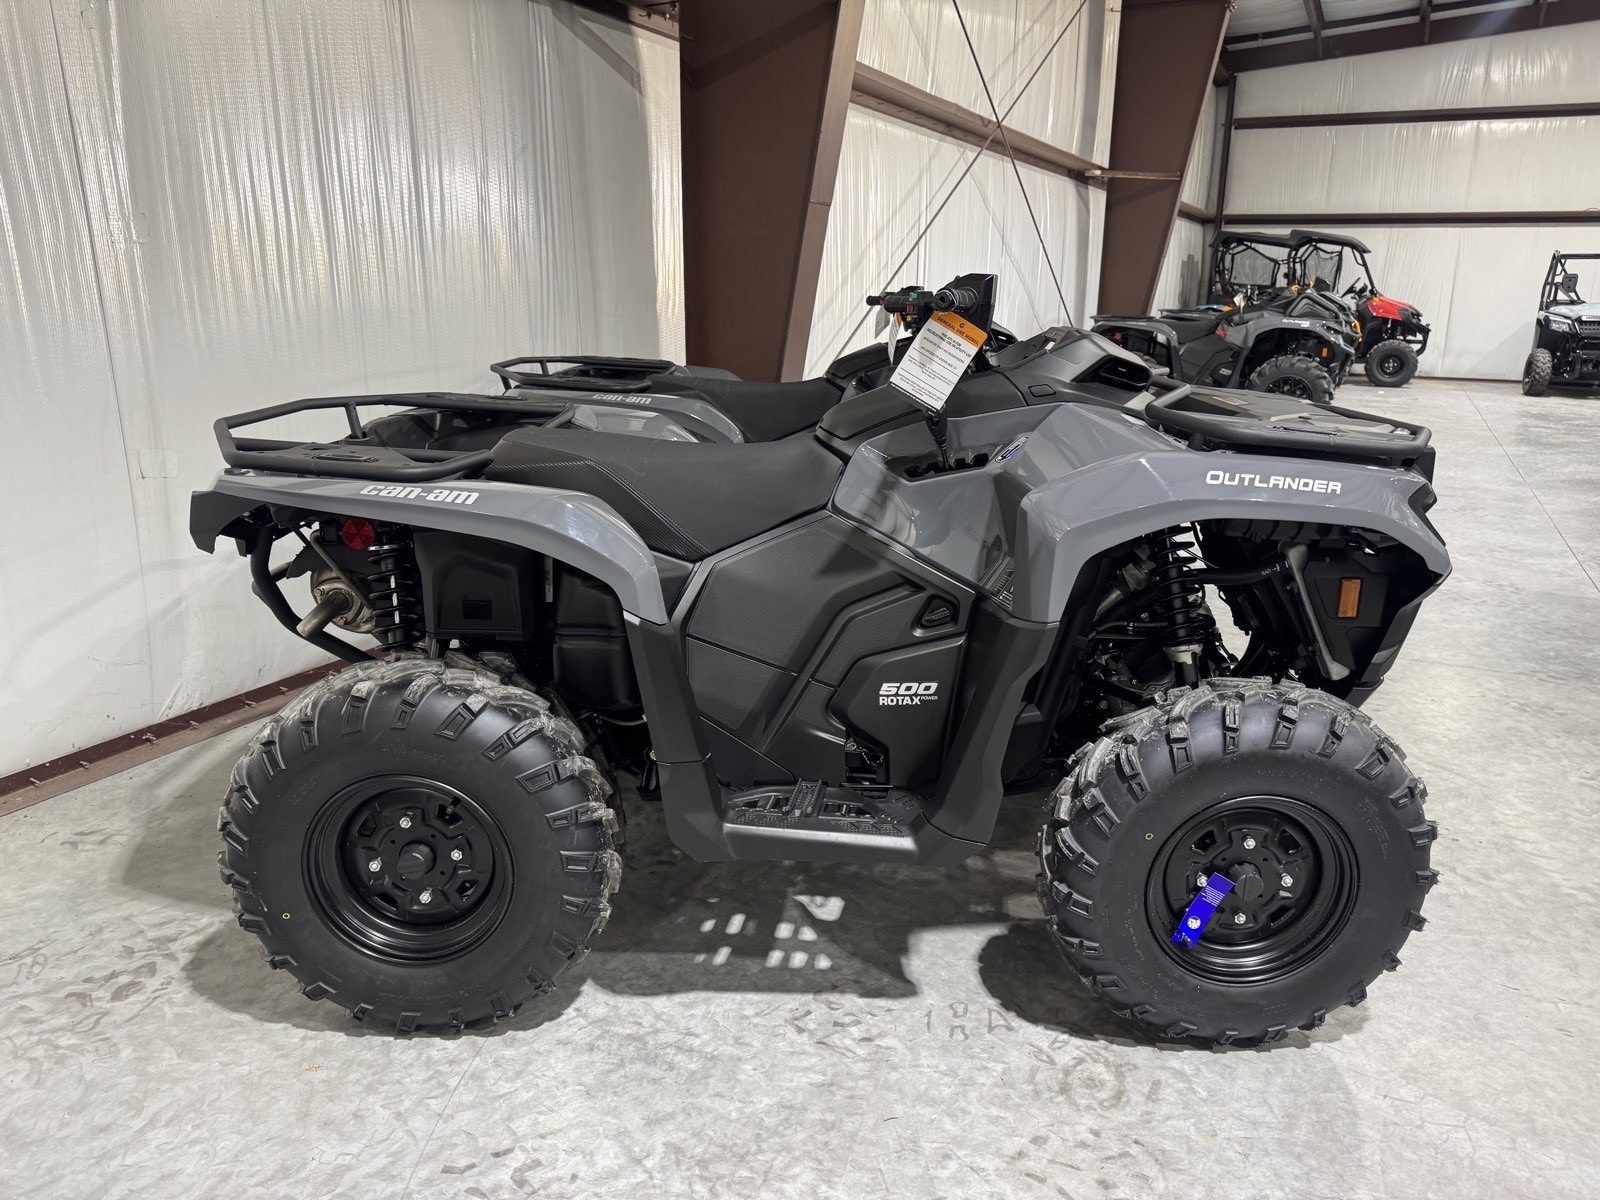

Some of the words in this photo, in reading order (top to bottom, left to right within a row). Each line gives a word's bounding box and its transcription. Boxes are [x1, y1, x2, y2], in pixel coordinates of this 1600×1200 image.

[937, 316, 956, 330] GENERAL
[956, 328, 965, 336] USE
[964, 334, 980, 345] MODEL
[592, 394, 652, 405] can-am
[1205, 470, 1342, 495] OUTLANDER
[359, 484, 480, 505] can-am
[879, 682, 938, 694] 500
[879, 696, 920, 705] ROTAX
